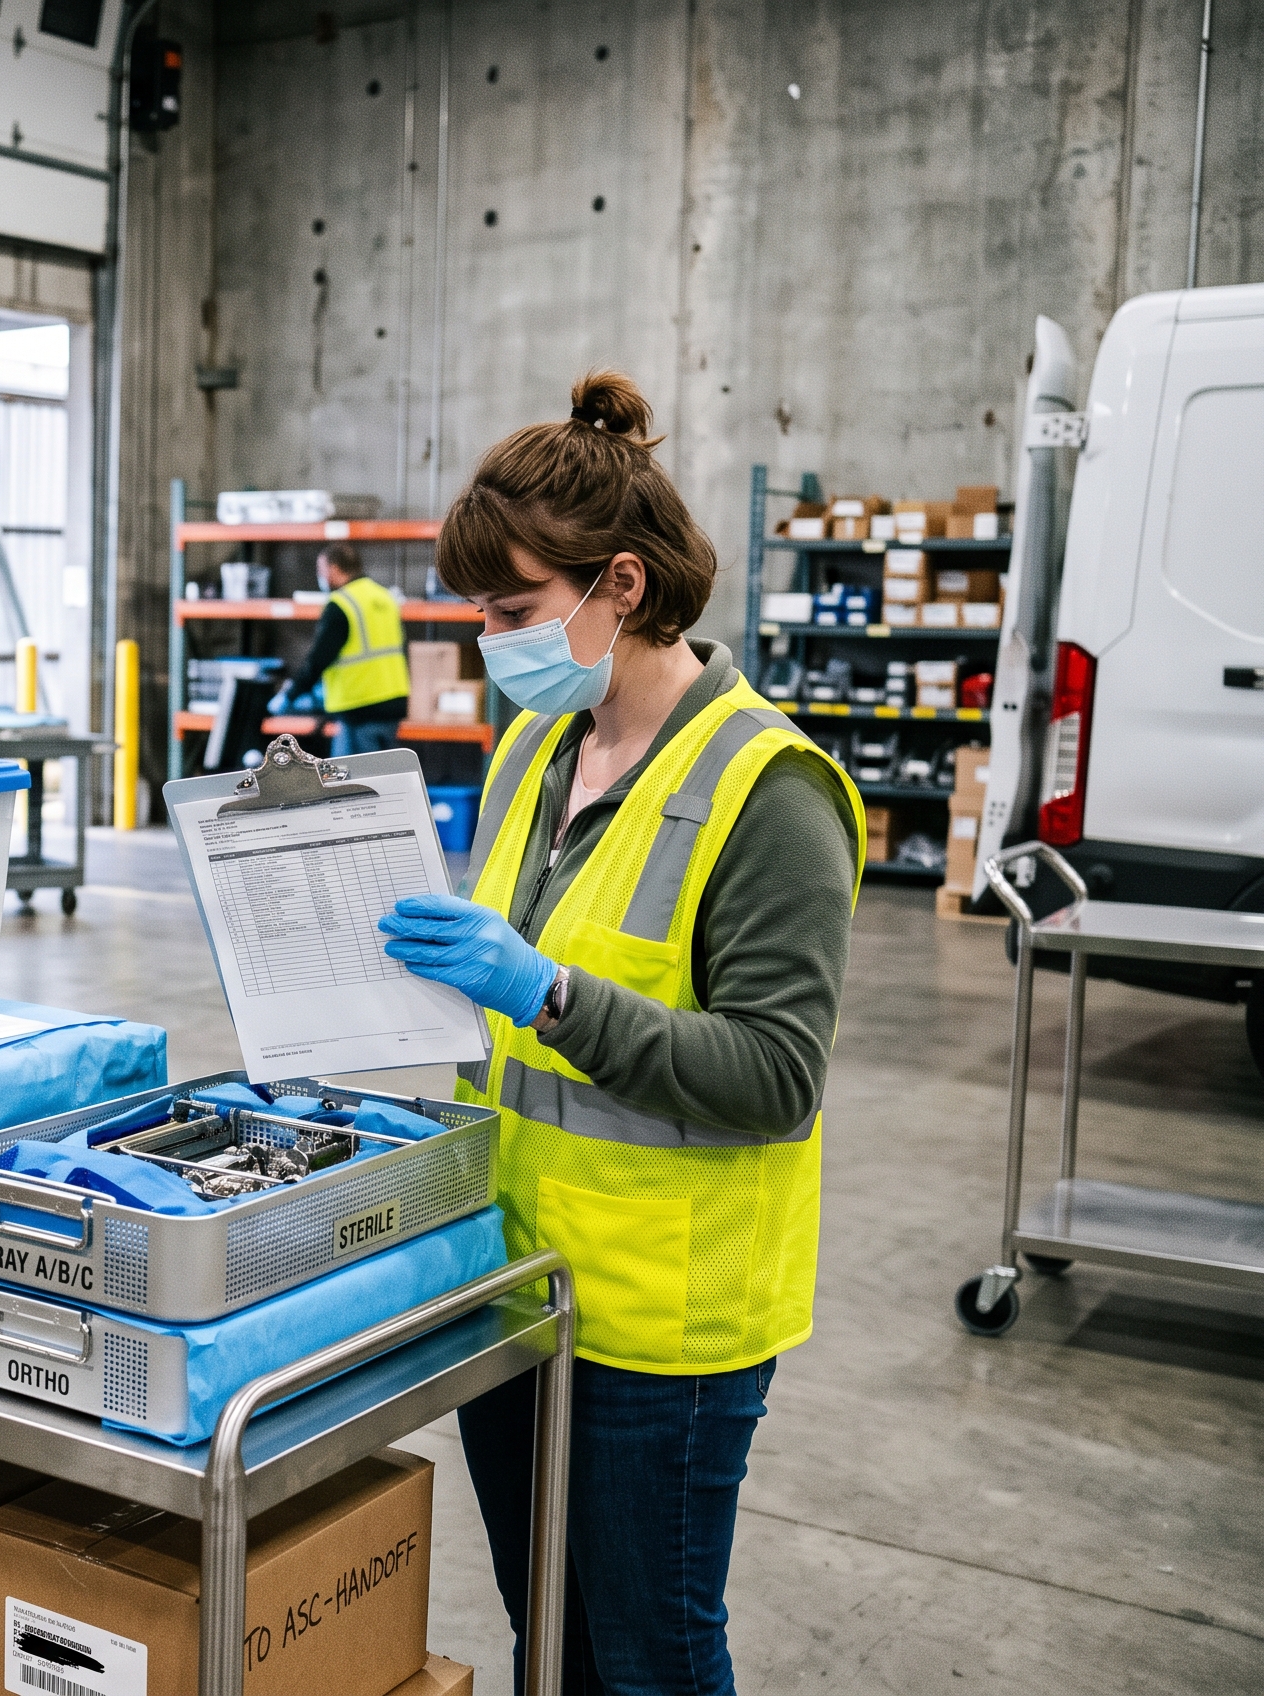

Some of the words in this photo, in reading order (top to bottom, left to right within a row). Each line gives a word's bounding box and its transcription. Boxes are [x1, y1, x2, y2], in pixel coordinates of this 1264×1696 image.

[339, 1207, 394, 1249] STERILE
[35, 1255, 94, 1290] A/B/C
[8, 1359, 70, 1396] ORTHO
[243, 1625, 271, 1672] TO
